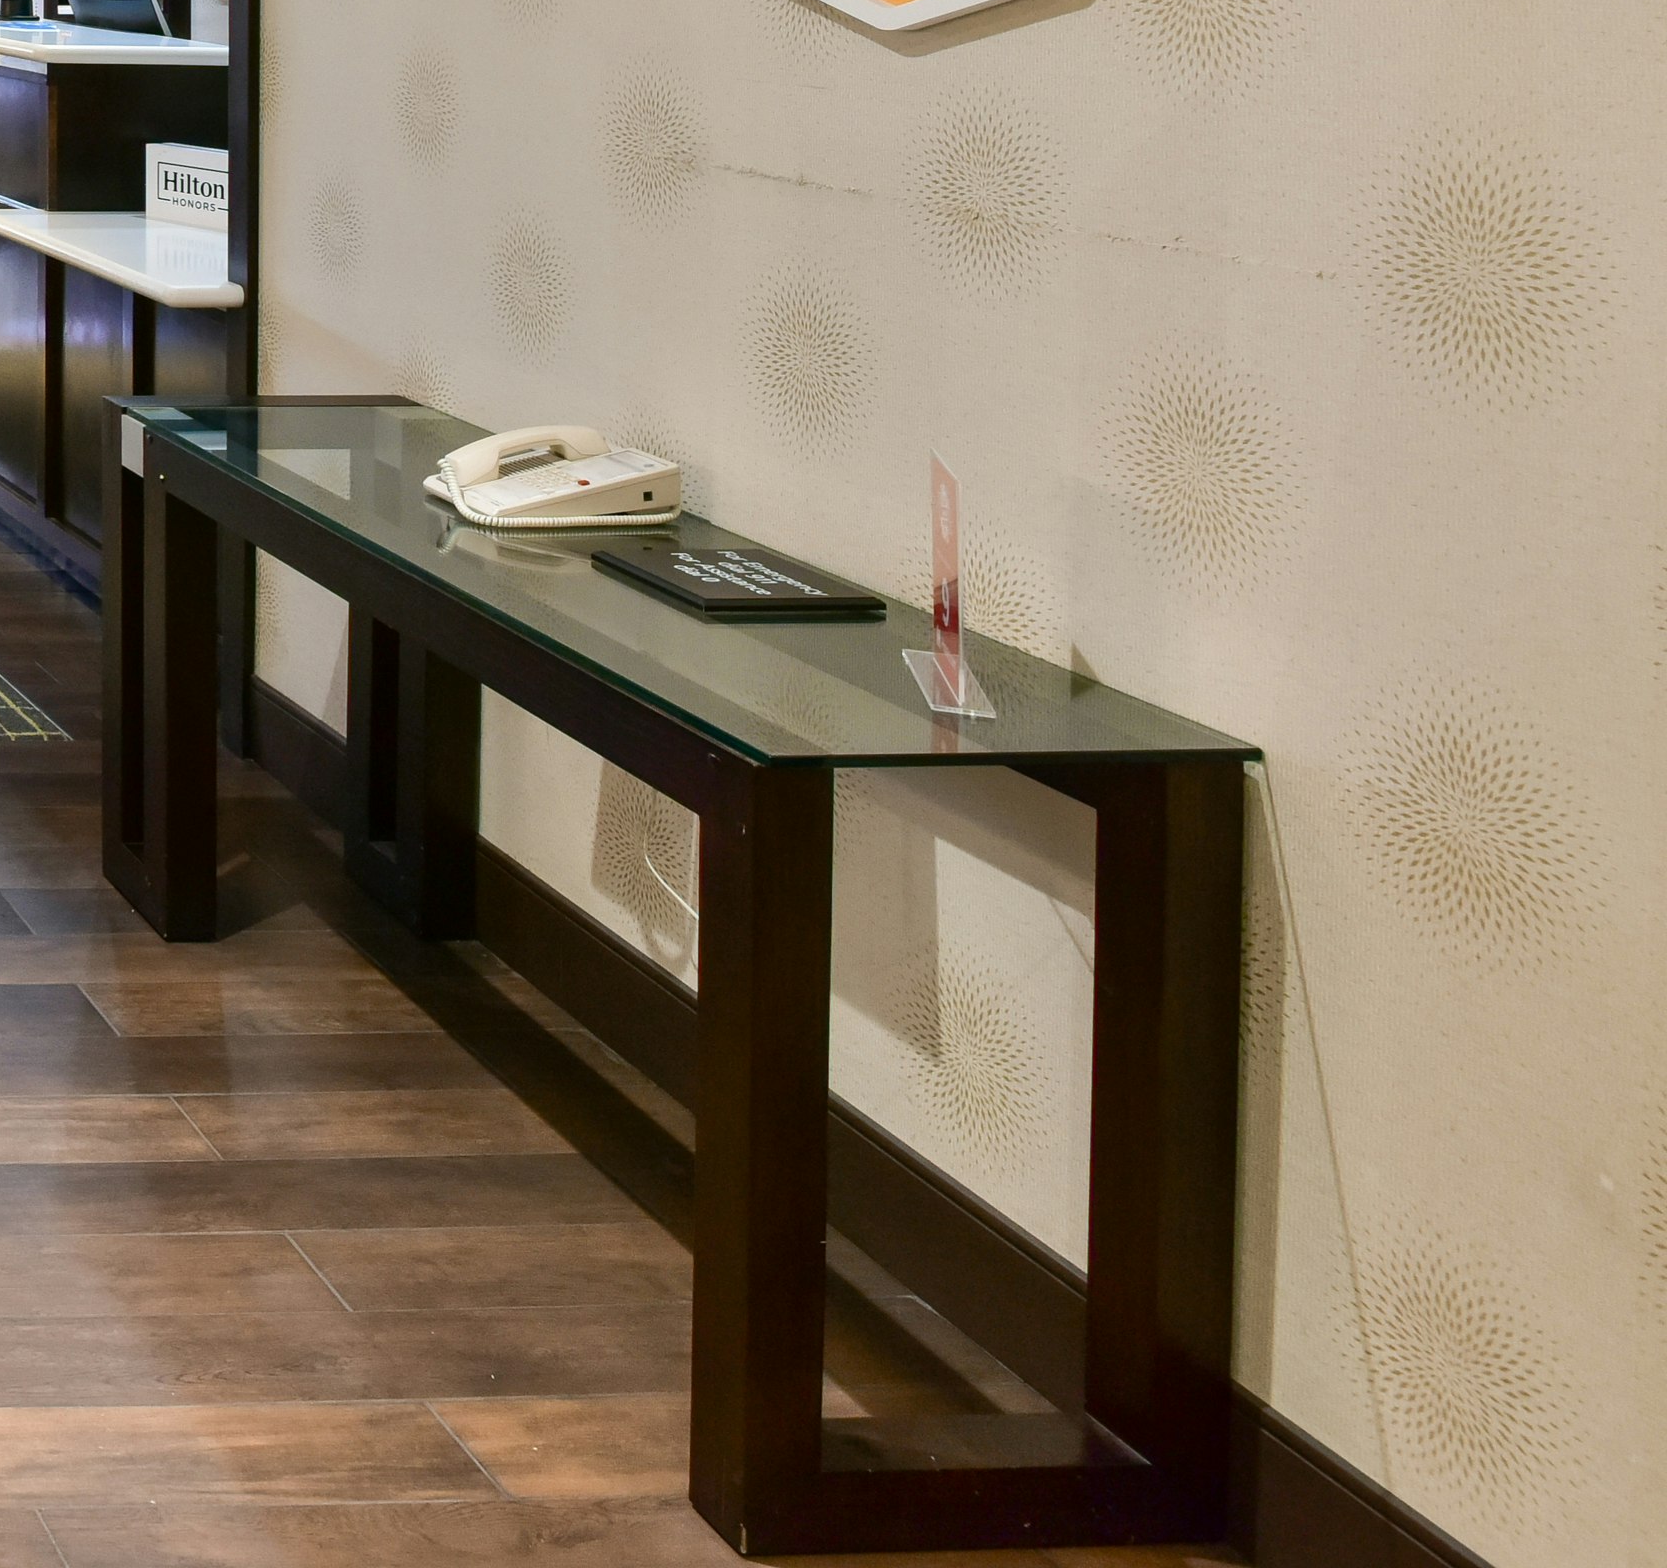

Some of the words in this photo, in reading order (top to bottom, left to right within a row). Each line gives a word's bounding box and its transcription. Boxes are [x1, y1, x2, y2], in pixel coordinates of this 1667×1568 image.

[163, 170, 225, 200] Hilton
[172, 197, 216, 212] HONORS
[670, 552, 701, 563] For
[694, 563, 772, 596] Assistance
[717, 550, 748, 562] For
[742, 561, 829, 597] Emergency
[745, 574, 778, 584] 911
